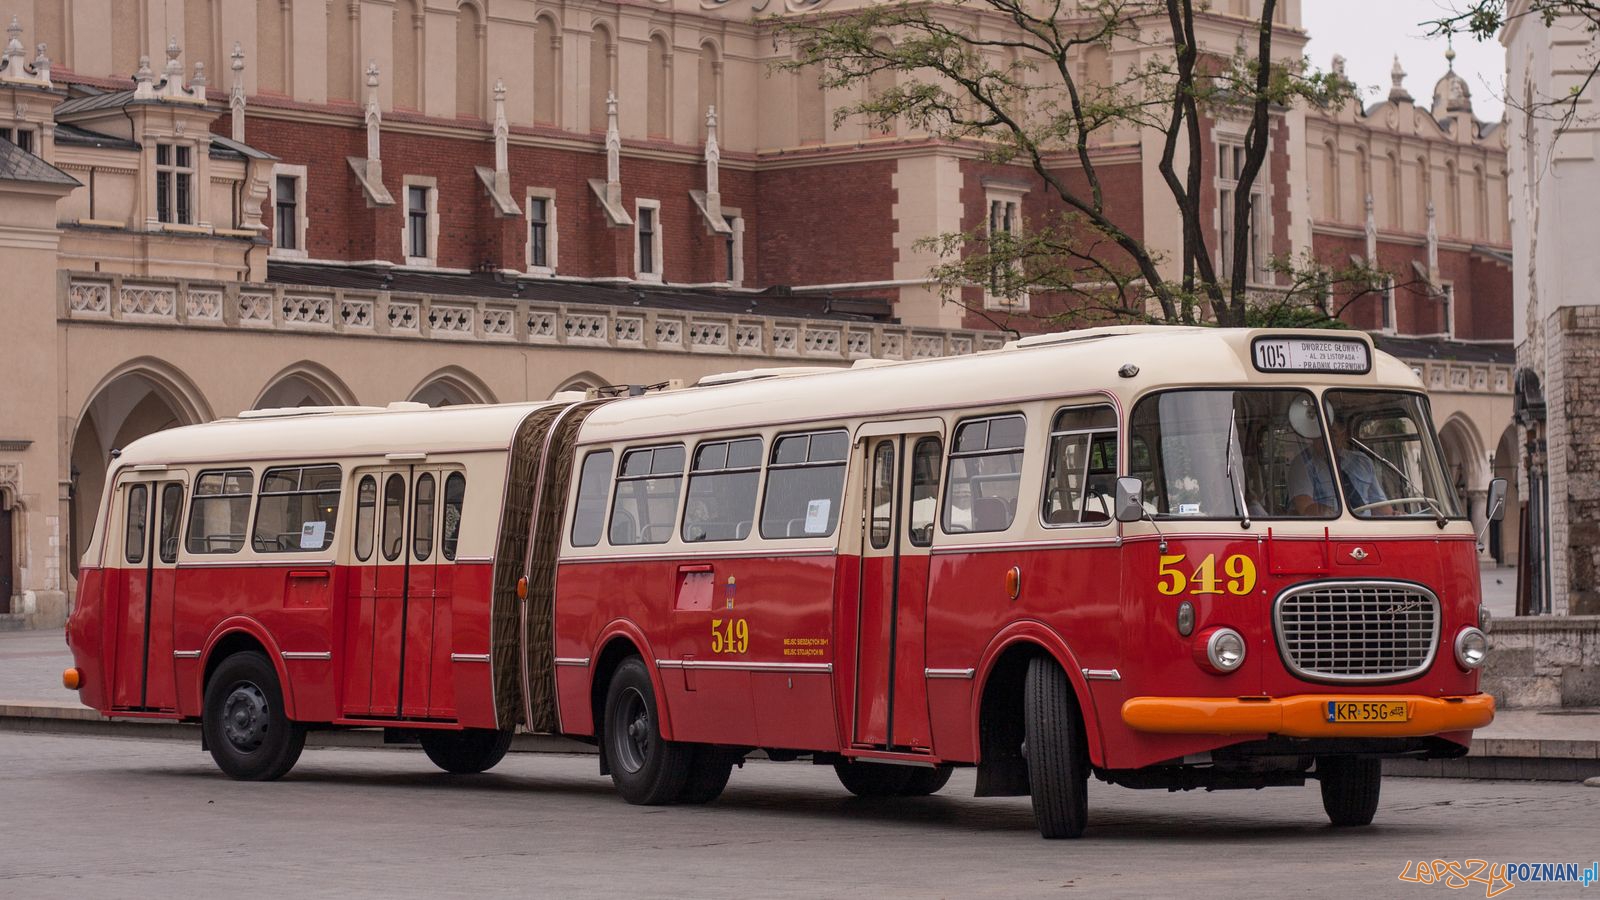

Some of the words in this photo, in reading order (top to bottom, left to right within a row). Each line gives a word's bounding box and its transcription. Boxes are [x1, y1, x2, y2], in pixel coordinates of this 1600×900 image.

[1259, 344, 1286, 368] 105
[1301, 342, 1332, 352] DWORZEC
[1327, 353, 1356, 361] LISTOPADA
[1157, 553, 1257, 597] 549
[711, 618, 749, 654] 549
[1337, 703, 1358, 720] KR
[1362, 703, 1388, 720] 55G
